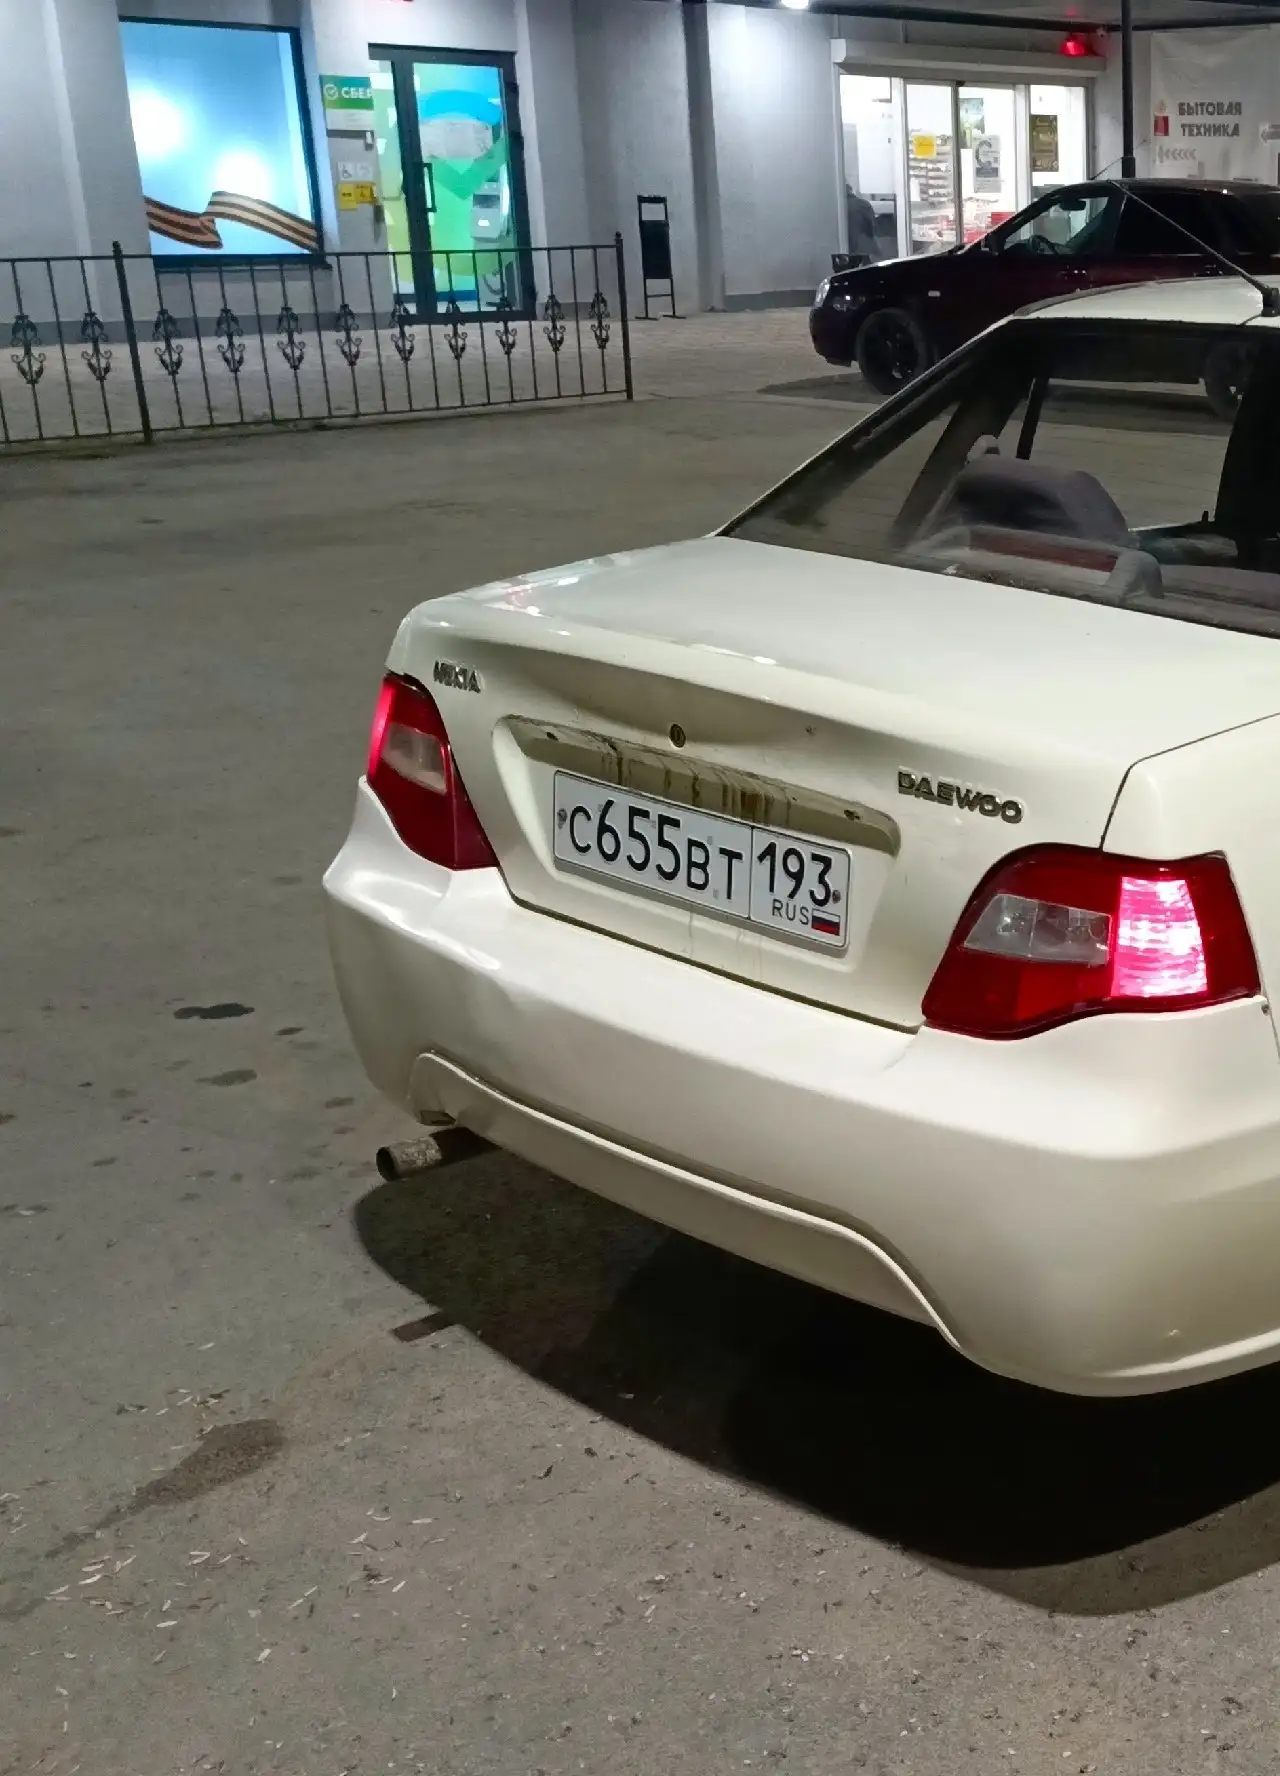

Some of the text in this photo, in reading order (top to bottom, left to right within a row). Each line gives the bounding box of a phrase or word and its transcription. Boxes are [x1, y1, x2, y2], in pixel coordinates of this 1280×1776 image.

[1178, 101, 1242, 116] БЫТОВАЯ
[1180, 122, 1240, 137] ТЕХНИКА
[898, 770, 1022, 824] DAEWOO
[757, 841, 833, 907] 193
[772, 898, 810, 926] RUS
